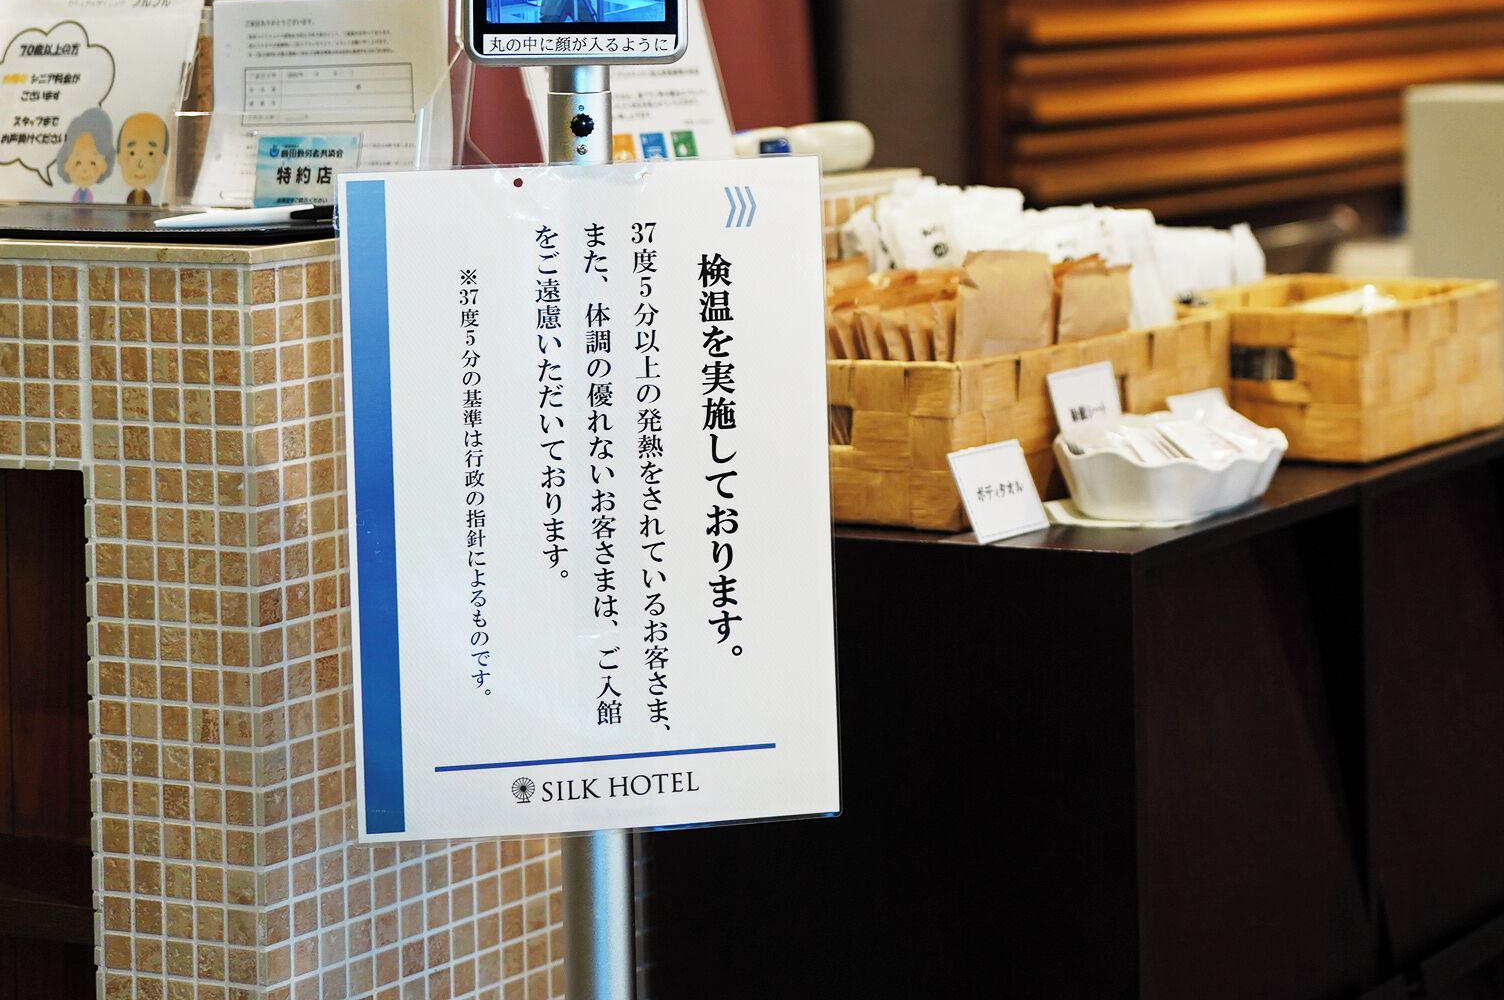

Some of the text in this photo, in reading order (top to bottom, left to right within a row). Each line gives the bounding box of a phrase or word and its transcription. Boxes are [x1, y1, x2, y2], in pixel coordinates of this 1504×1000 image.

[489, 36, 669, 53] 丸の中に顔が入るように
[276, 166, 333, 185] 特約店
[534, 224, 569, 579] をご遠慮いただいております。
[630, 222, 671, 731] 37度5分以上の発熱をされているお客さま、
[697, 253, 743, 657] 検温を実施しております。
[541, 771, 700, 803] SILK HOTEL
